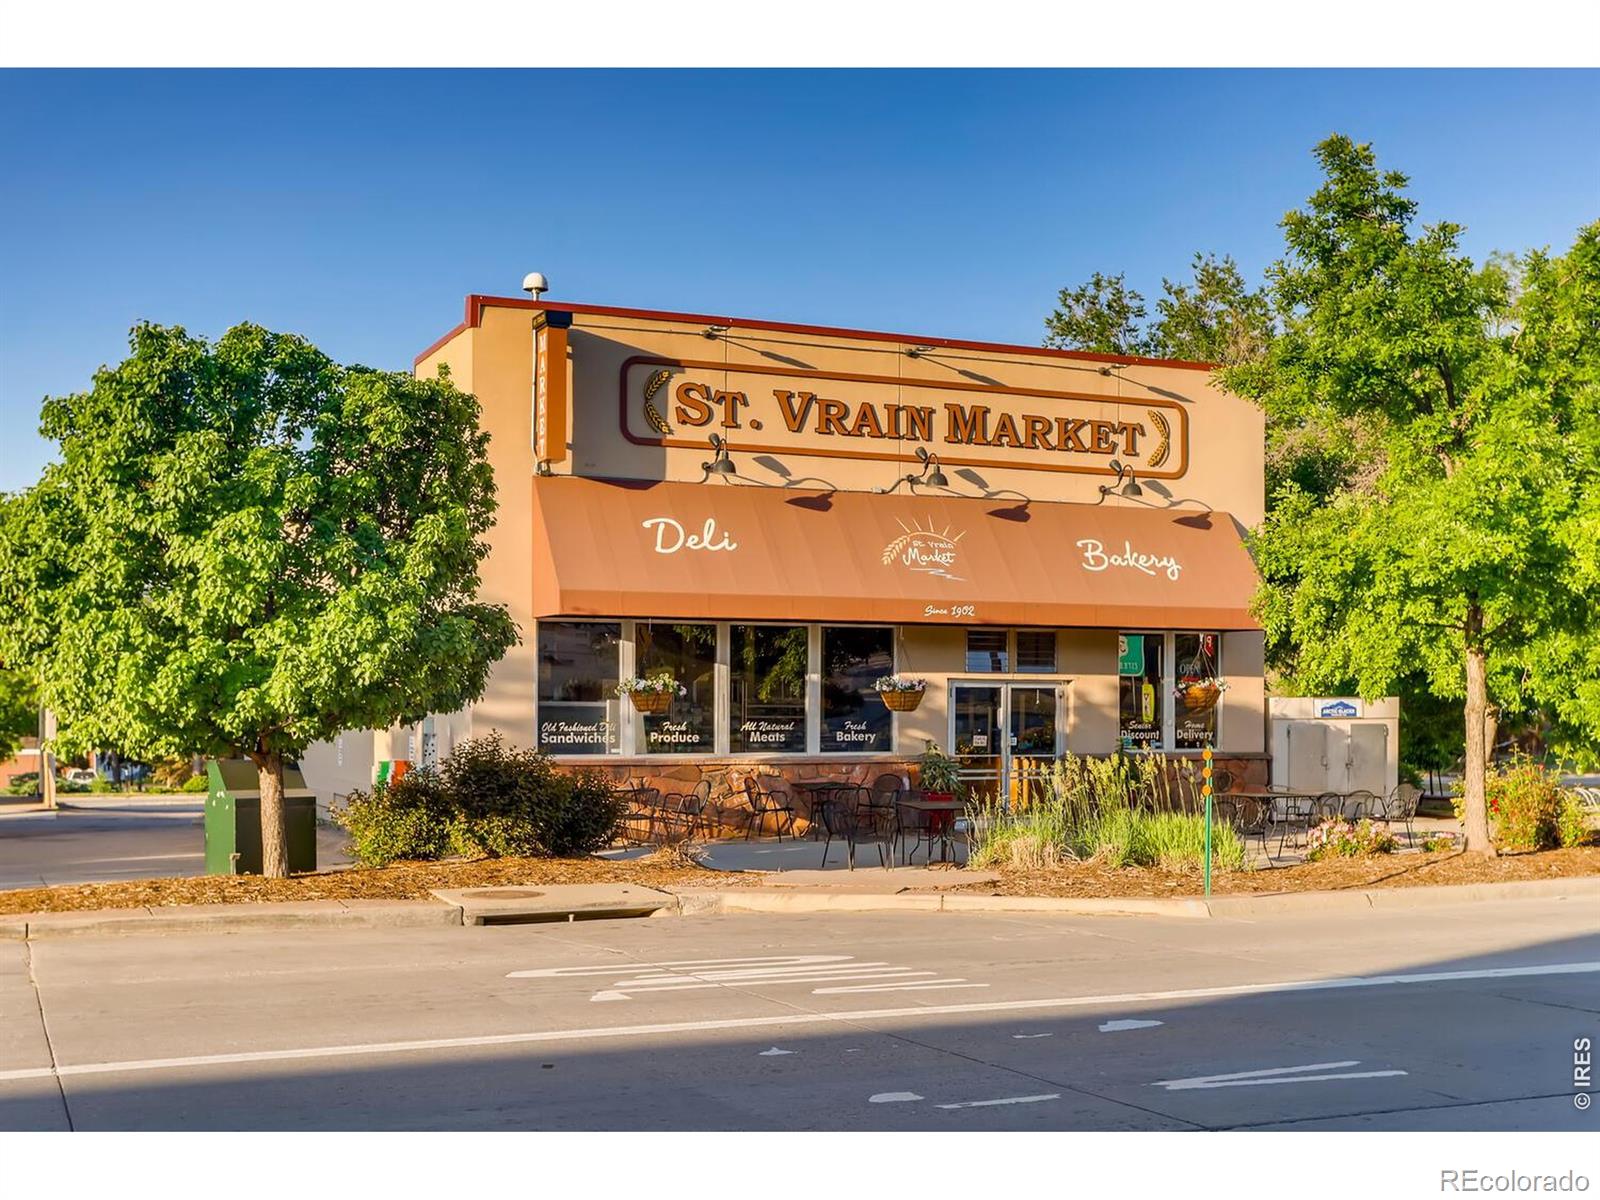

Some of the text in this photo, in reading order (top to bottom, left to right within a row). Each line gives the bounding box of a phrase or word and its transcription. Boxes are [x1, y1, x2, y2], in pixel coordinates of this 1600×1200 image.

[675, 382, 1146, 456] ST. VRAIN MARKET
[642, 518, 738, 553] Deli
[902, 547, 956, 567] Market
[1076, 539, 1182, 580] Bakery
[924, 605, 975, 618] Since 1902
[541, 722, 556, 732] Old
[558, 721, 597, 732] Fashioned
[662, 721, 688, 732] Fresh
[740, 721, 795, 732] All Natural
[844, 721, 867, 730] Fresh
[541, 732, 616, 744] Sandwiches
[650, 732, 700, 743] Produce
[750, 731, 786, 742] Meats
[836, 731, 876, 743] Bakery
[1121, 730, 1160, 740] Discount
[1176, 729, 1214, 741] Delivery
